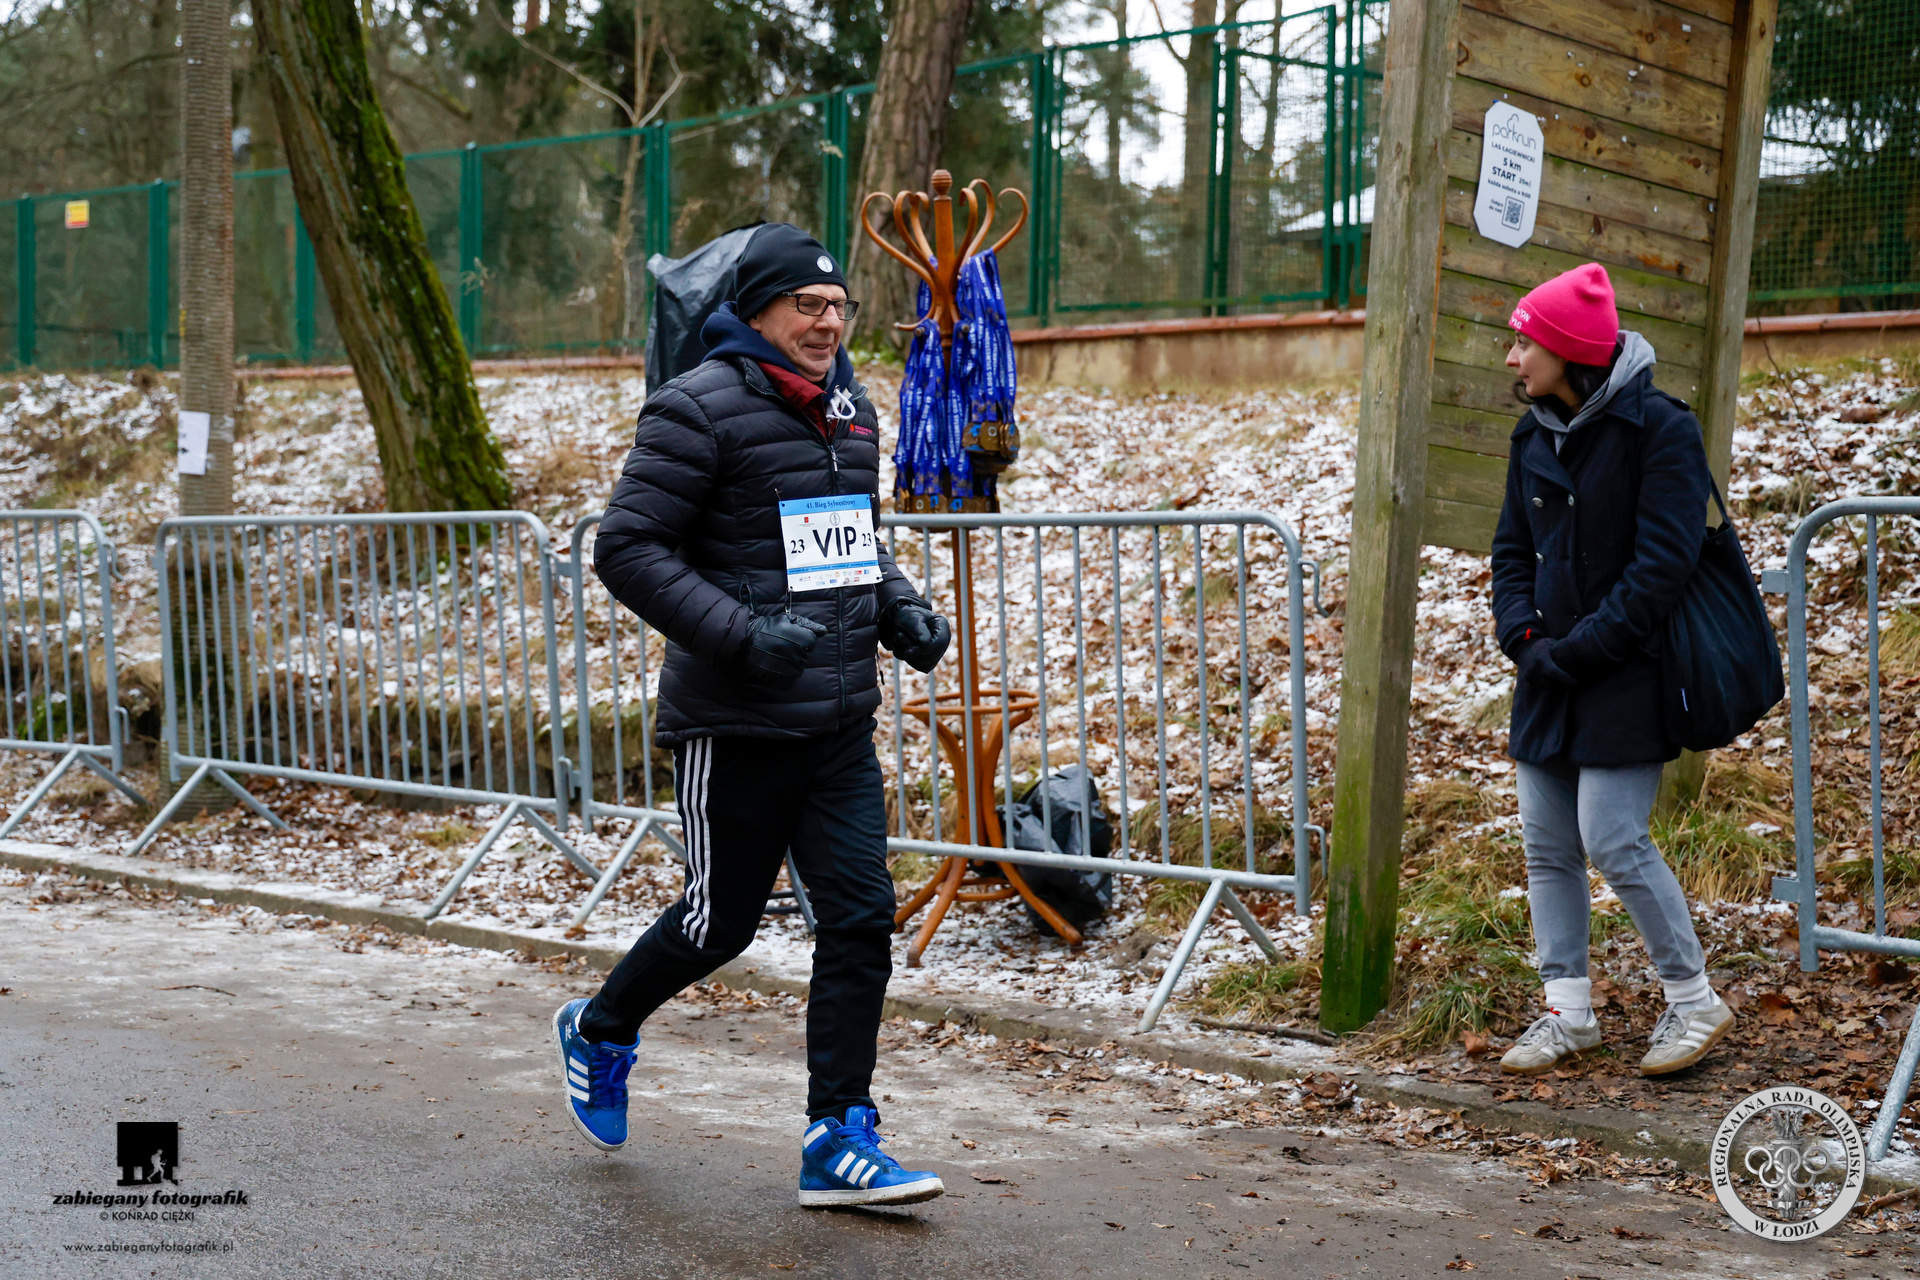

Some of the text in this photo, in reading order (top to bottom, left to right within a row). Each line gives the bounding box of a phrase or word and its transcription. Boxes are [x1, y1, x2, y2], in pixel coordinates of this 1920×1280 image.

[1492, 113, 1537, 150] parkrun
[1492, 166, 1517, 183] START
[1503, 157, 1522, 172] 5 km
[790, 526, 872, 558] 23 VIP 23
